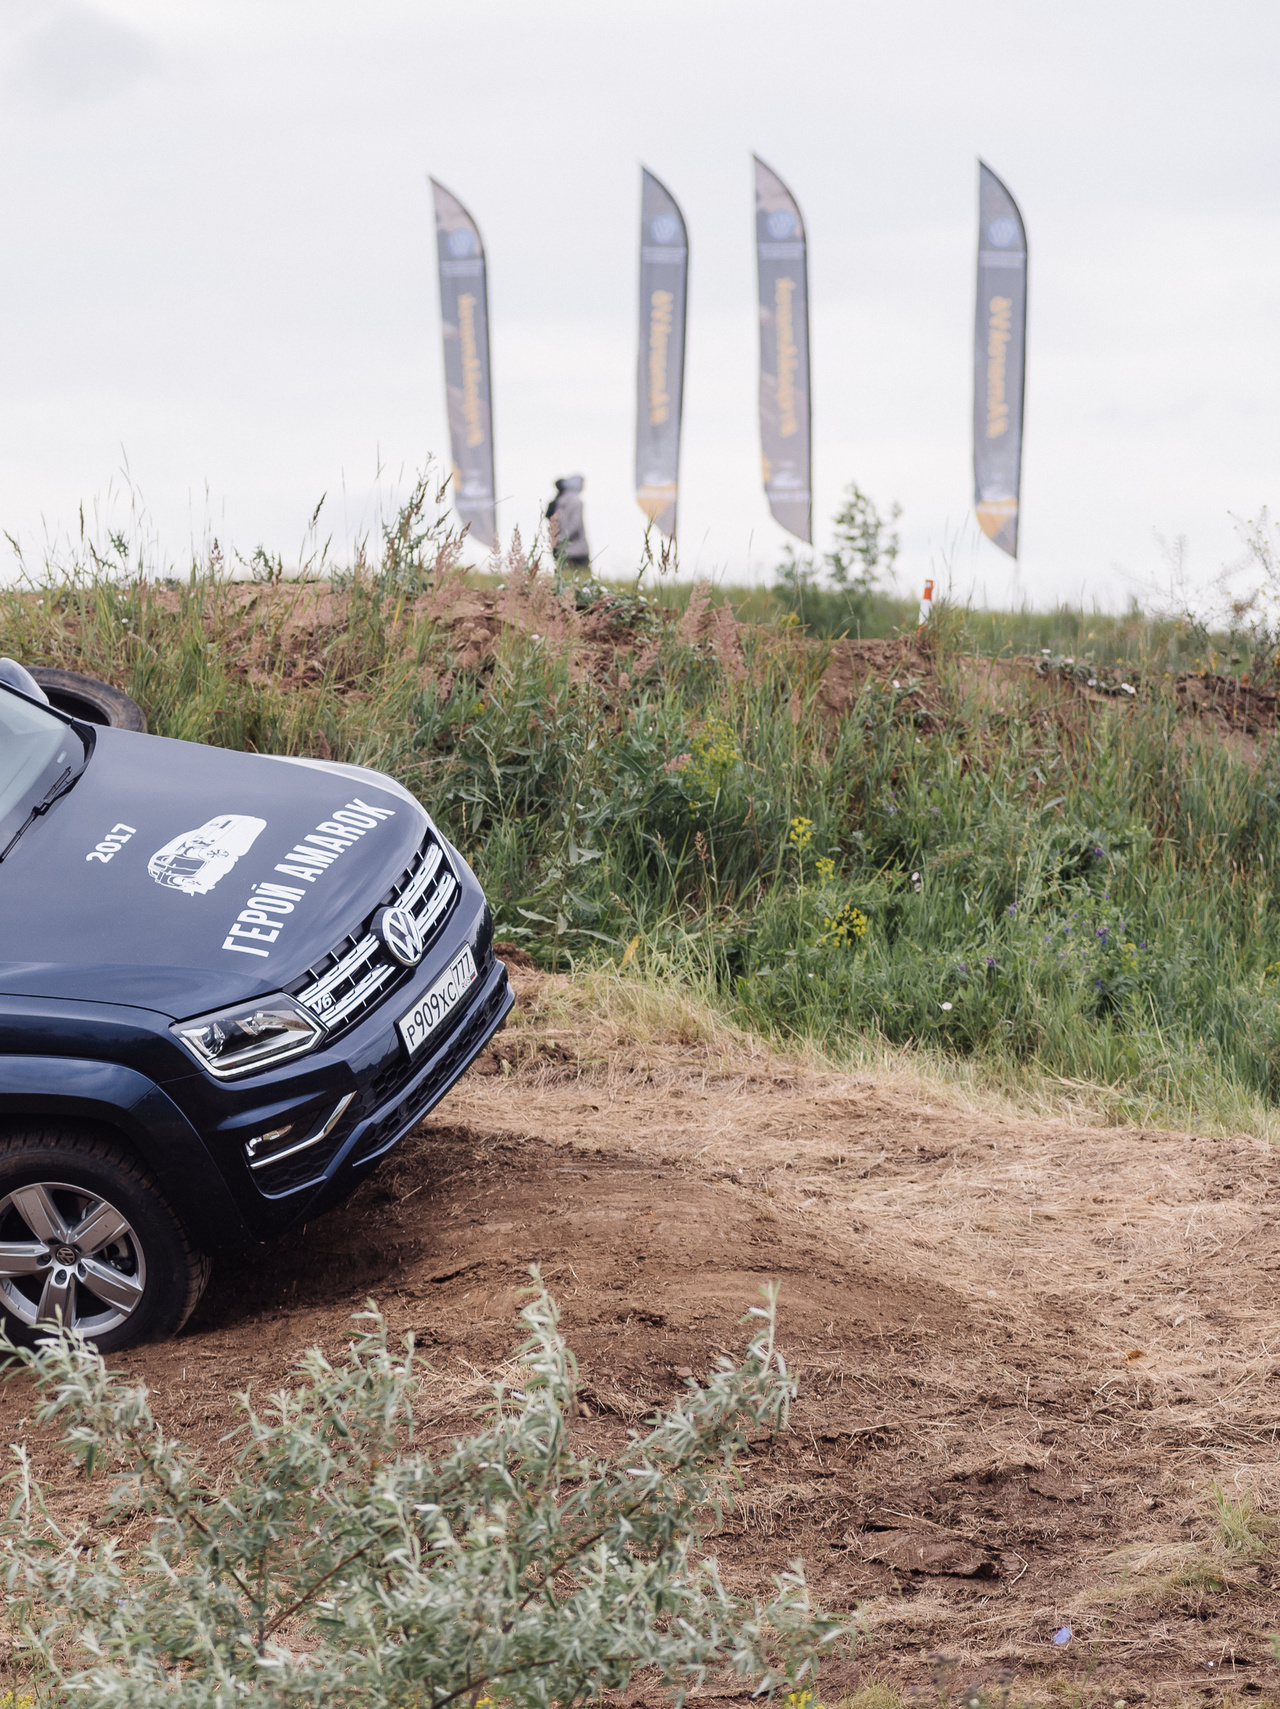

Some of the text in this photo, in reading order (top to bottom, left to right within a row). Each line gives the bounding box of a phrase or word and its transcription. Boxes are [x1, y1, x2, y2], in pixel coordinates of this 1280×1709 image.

[86, 823, 137, 863] 2017
[222, 798, 396, 957] ГЕРОЙ AMAROK
[452, 952, 471, 986] 777
[311, 993, 332, 1014] V6
